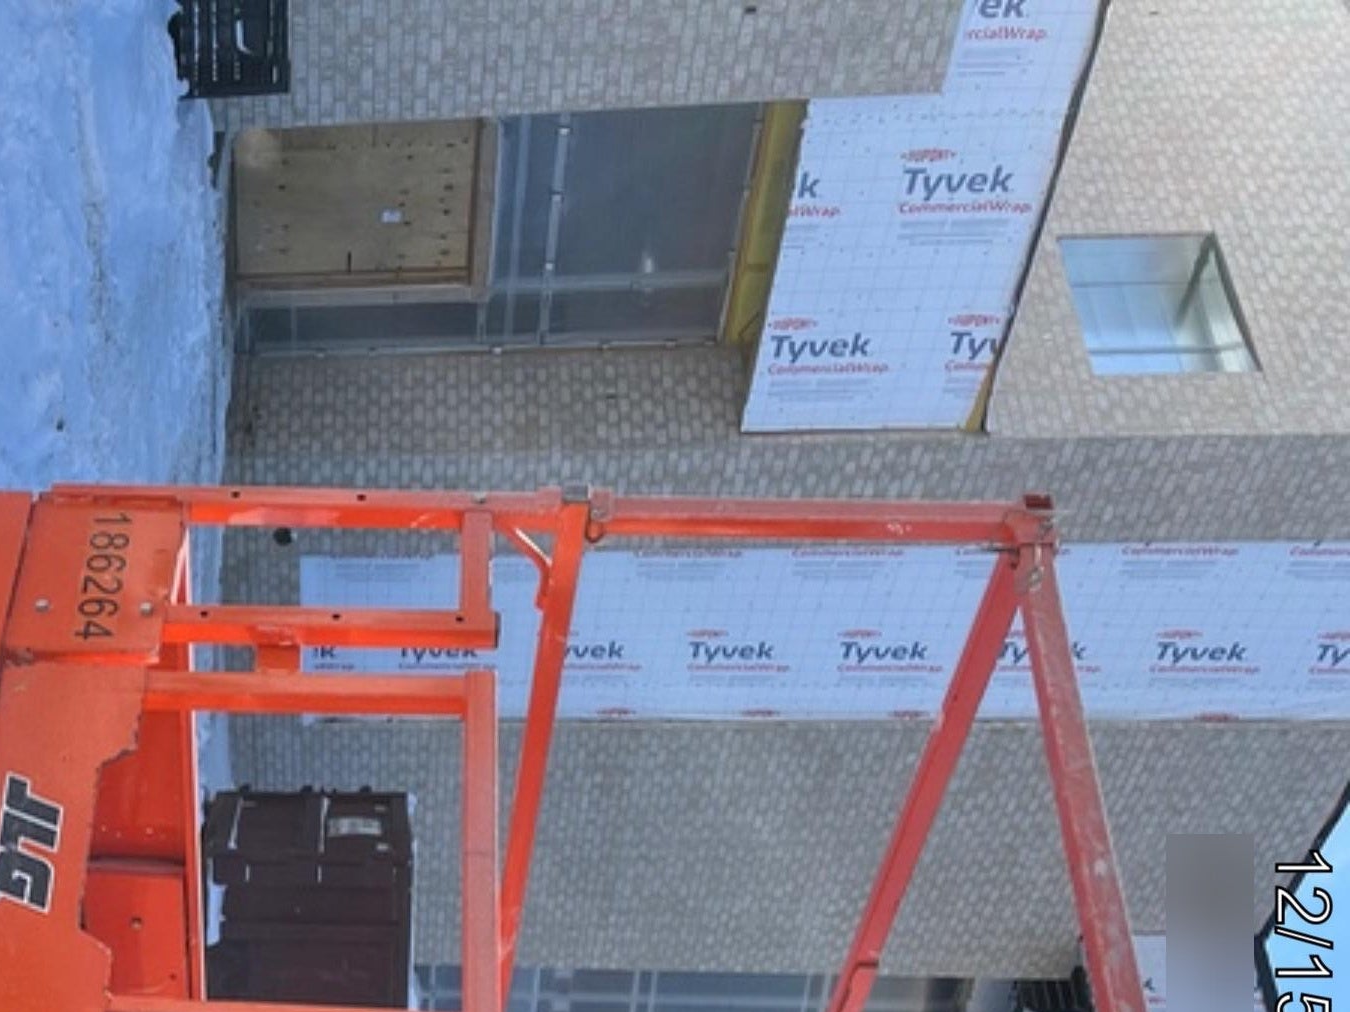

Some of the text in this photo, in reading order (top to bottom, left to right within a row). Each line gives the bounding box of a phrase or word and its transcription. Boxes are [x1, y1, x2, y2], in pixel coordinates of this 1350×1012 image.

[967, 26, 1046, 41] rcialWrap
[903, 166, 1013, 201] Tyvek
[899, 200, 1033, 216] CommercialWrap
[771, 333, 870, 364] Tyvek
[951, 332, 1000, 361] Tyv
[74, 512, 132, 641] 186264
[689, 641, 775, 664] Tyvek
[841, 641, 929, 664] Tyvek
[1157, 641, 1248, 665] Tyvek
